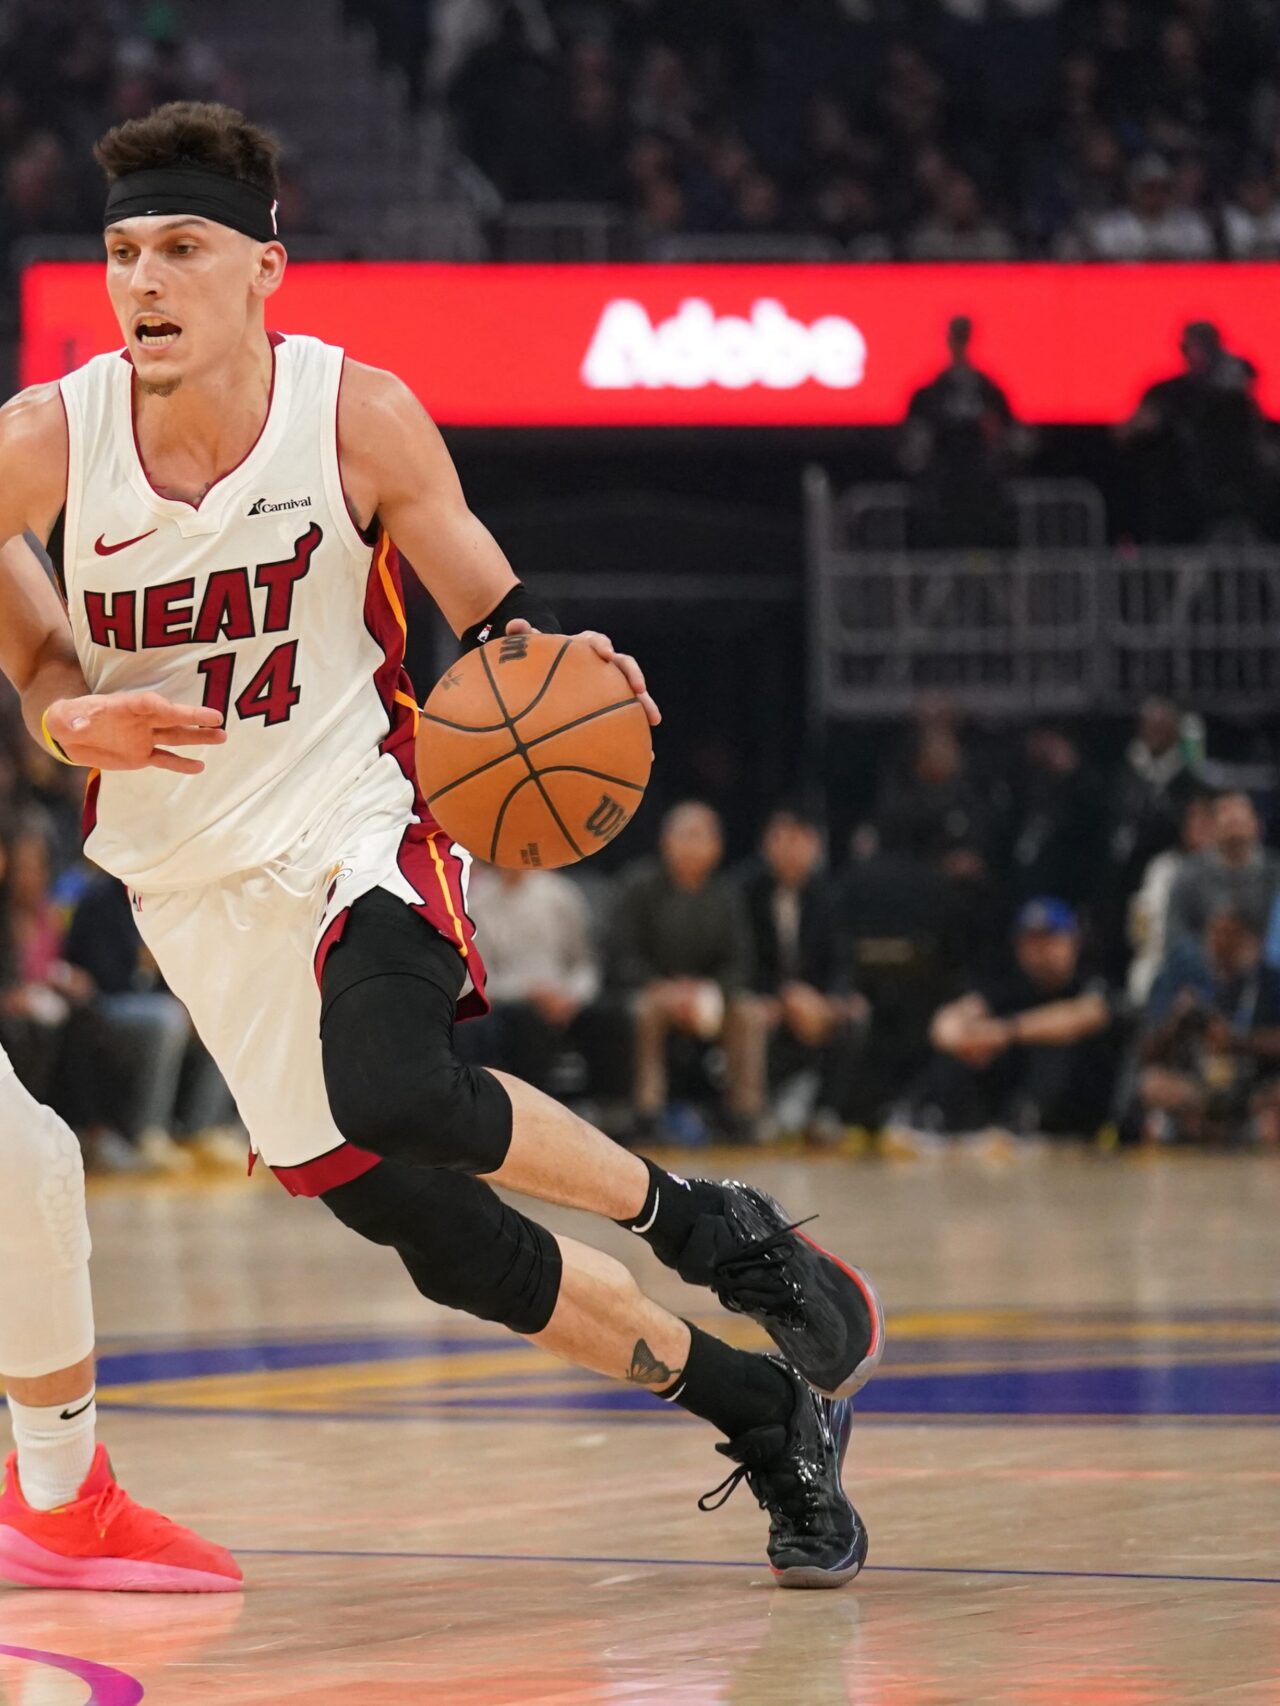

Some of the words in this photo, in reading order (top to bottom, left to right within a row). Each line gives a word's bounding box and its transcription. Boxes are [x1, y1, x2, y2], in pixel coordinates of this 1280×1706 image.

[581, 297, 867, 389] Adobe
[261, 496, 312, 514] Carnival
[83, 521, 324, 653] HEAT
[197, 639, 301, 730] 14
